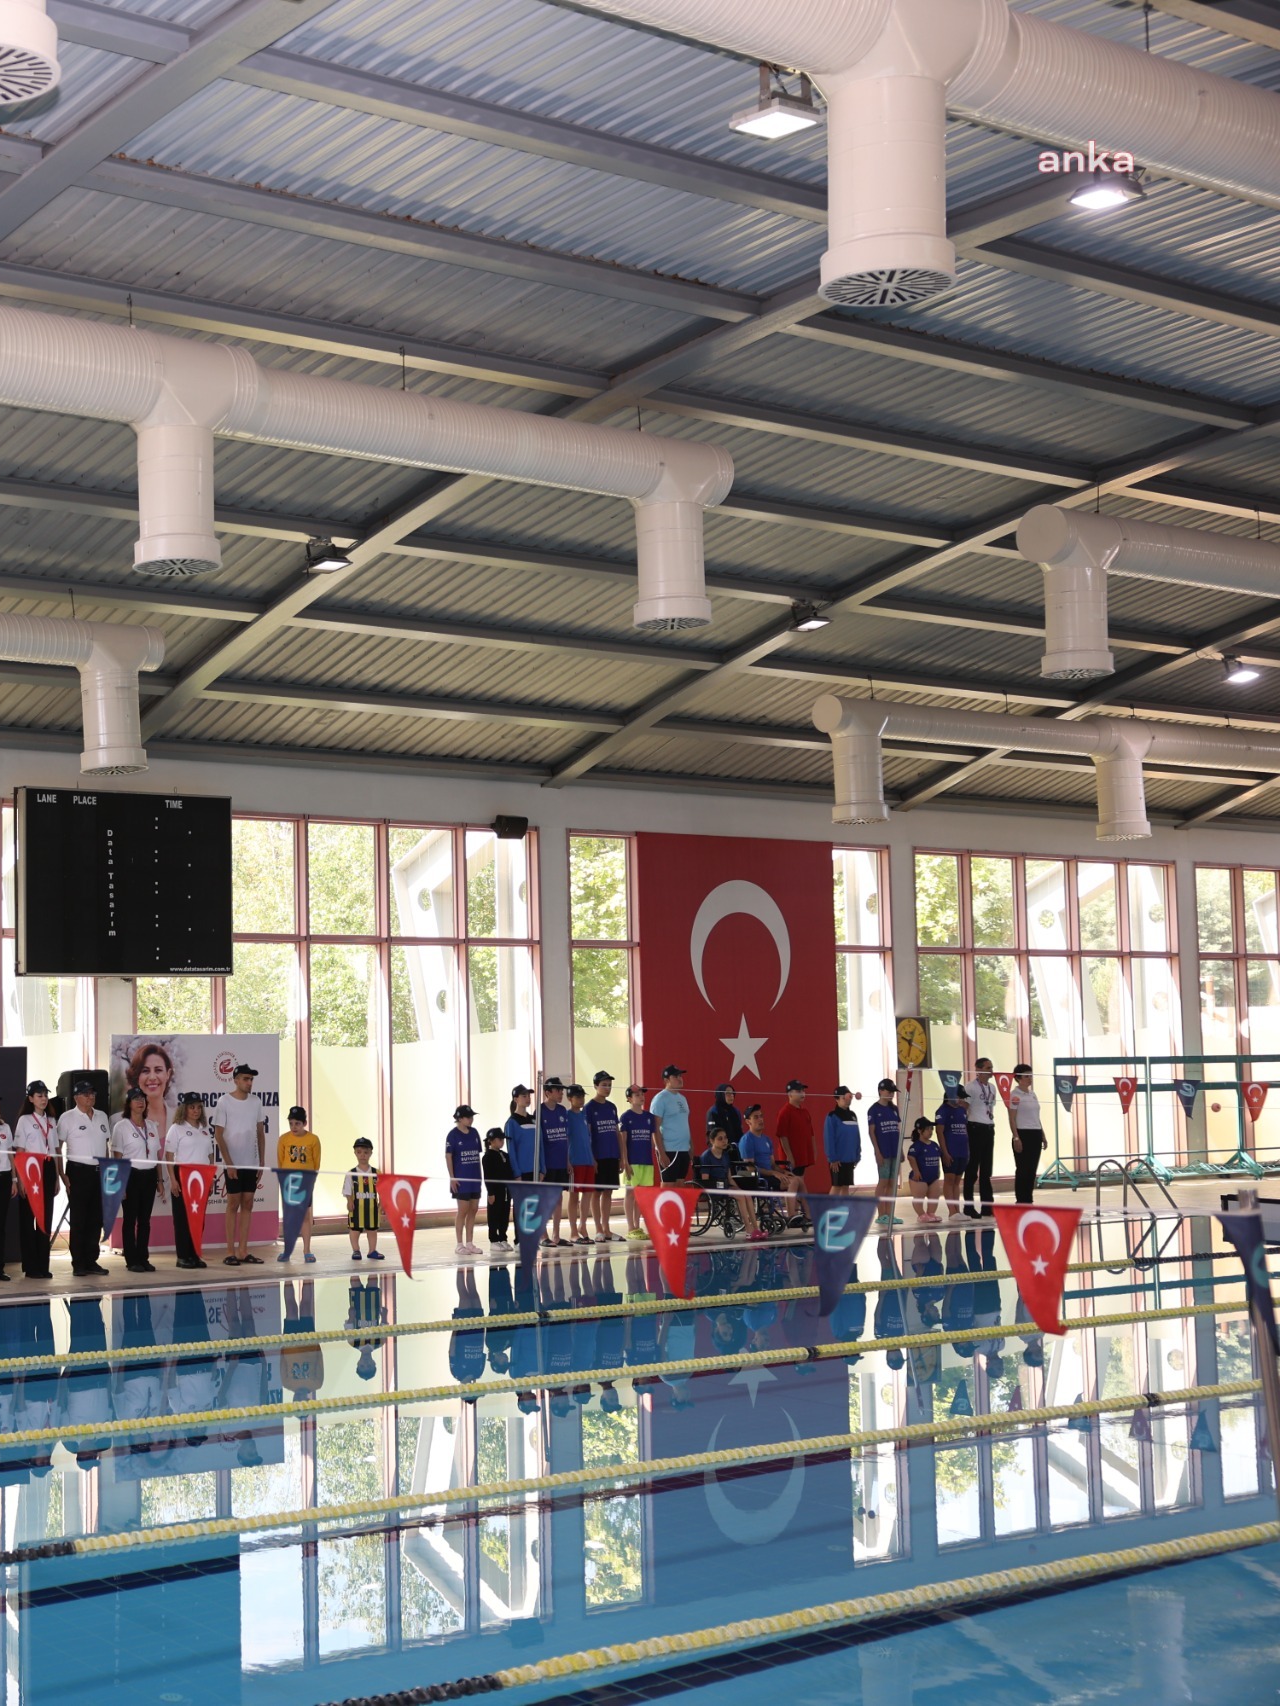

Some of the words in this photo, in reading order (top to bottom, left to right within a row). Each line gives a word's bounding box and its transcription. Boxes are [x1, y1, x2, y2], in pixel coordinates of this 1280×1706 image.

[36, 793, 57, 803] LANE
[72, 795, 97, 805] PLACE
[164, 799, 183, 809] TIME
[106, 829, 114, 865] Data
